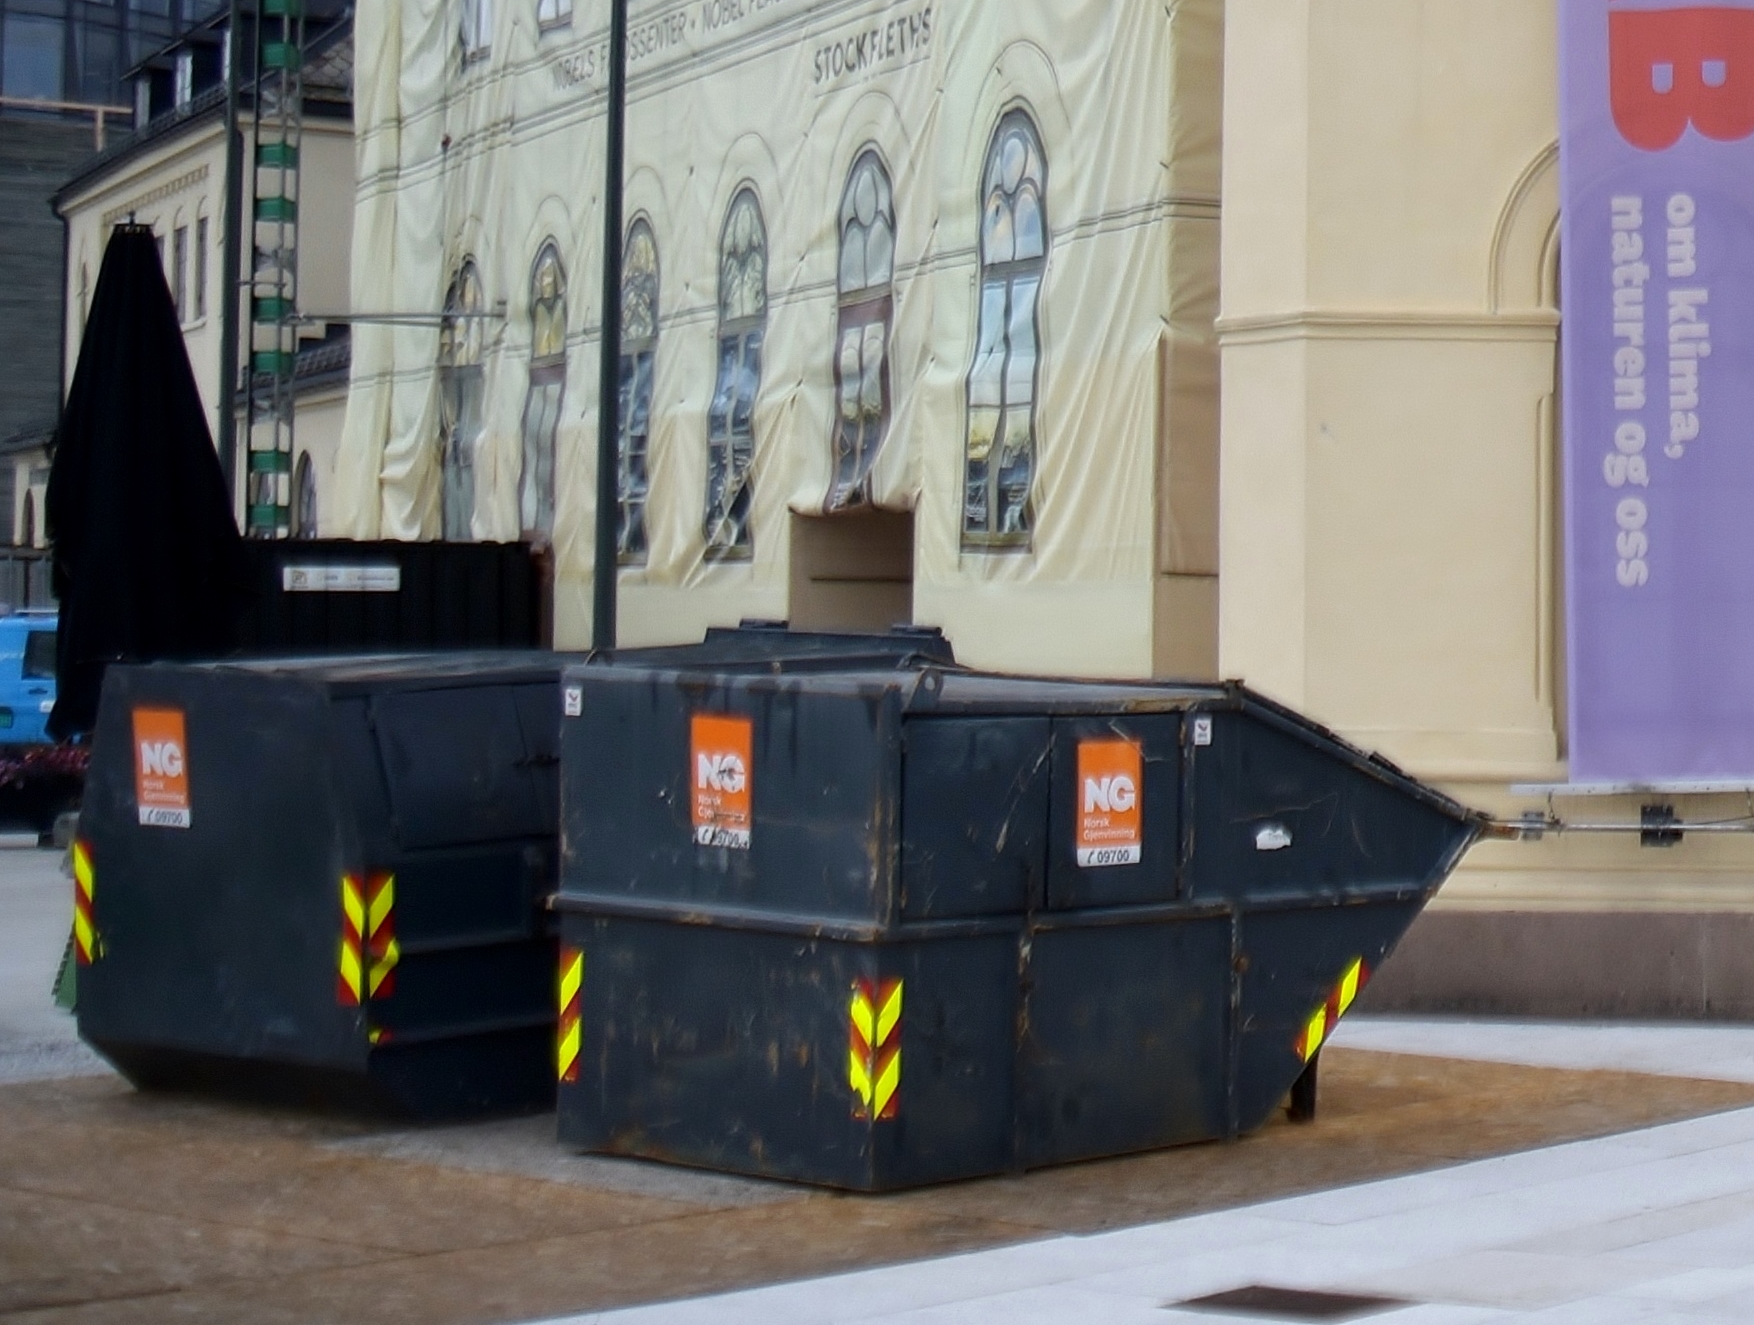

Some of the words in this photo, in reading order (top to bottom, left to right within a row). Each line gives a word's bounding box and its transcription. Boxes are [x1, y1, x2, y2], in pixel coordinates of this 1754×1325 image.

[600, 11, 687, 75] FSSENTER
[813, 6, 932, 85] STOCKFLETHS
[1666, 193, 1697, 278] om
[1611, 195, 1650, 410] naturen
[1664, 287, 1712, 459] klima,
[1603, 421, 1650, 488] og
[1615, 497, 1649, 588] oss
[141, 742, 183, 778] NG
[698, 753, 745, 793] NG
[1083, 818, 1110, 829] Norsk
[1084, 776, 1135, 812] NG
[1083, 829, 1136, 842] Gjenvinning
[1096, 848, 1130, 864] 09700
